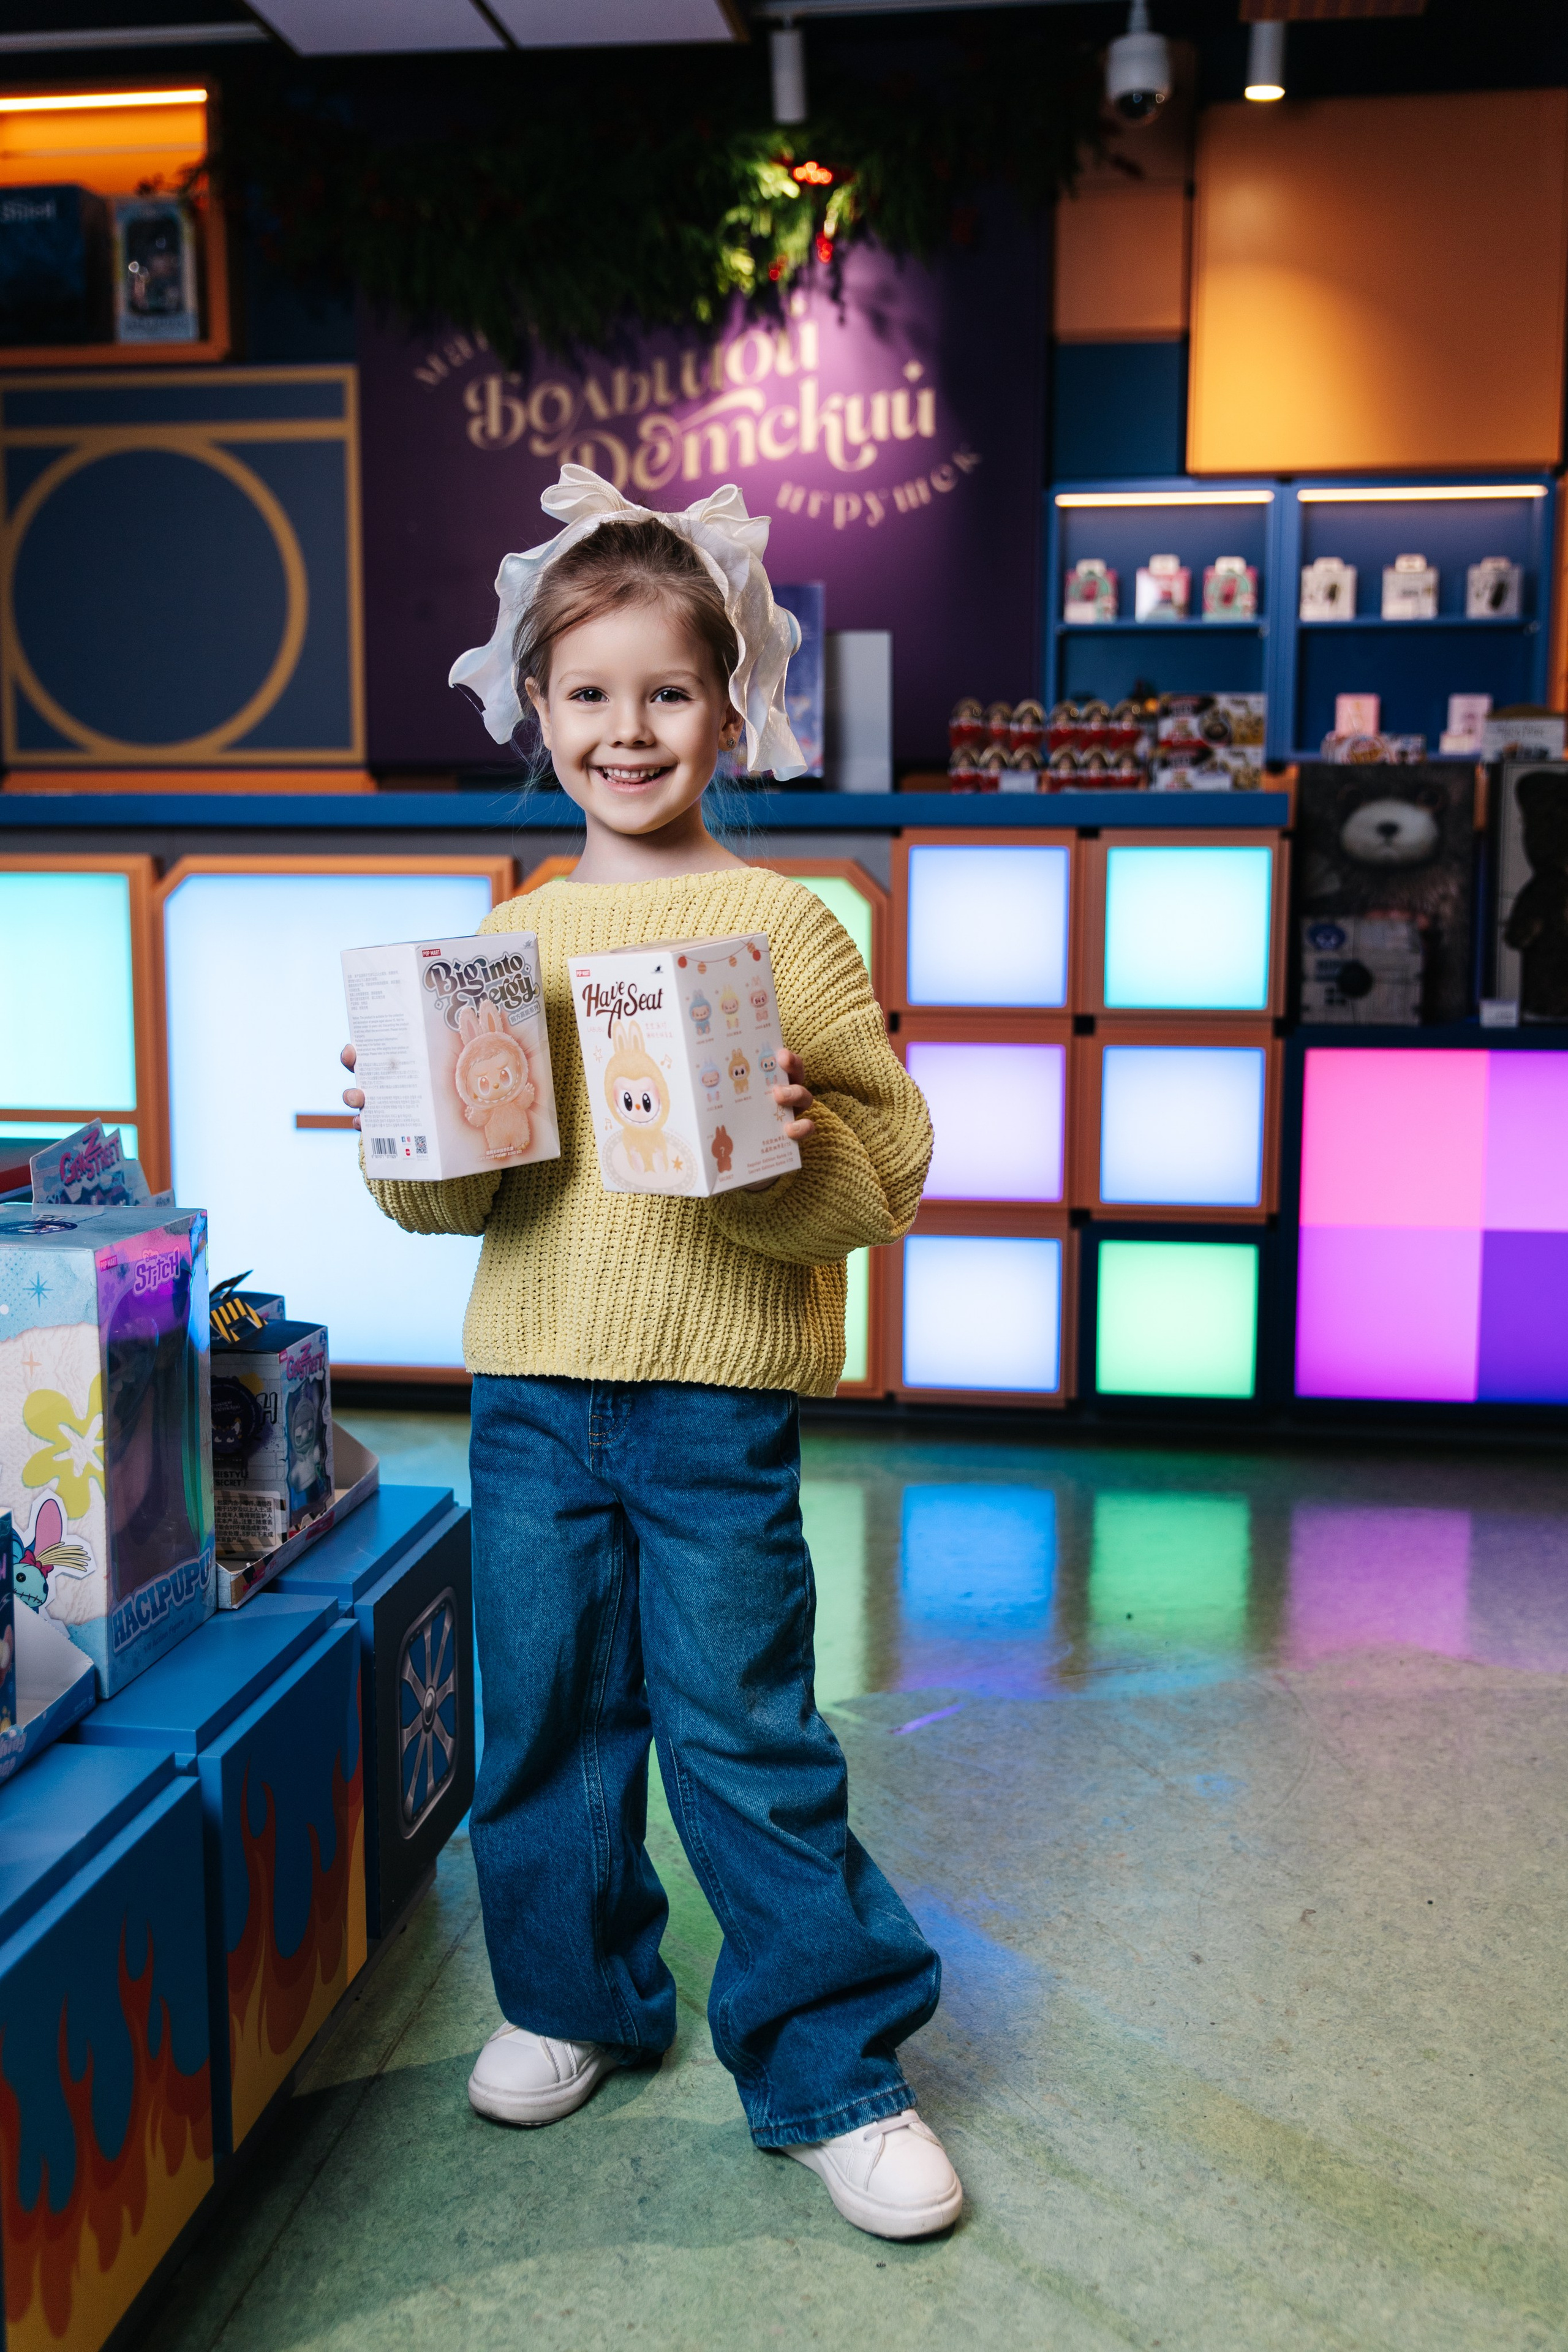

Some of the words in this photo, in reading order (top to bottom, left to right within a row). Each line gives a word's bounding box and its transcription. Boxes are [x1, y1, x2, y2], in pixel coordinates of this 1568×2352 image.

[424, 958, 486, 997] Big
[480, 955, 523, 985] into
[582, 981, 625, 1017] Have
[595, 998, 623, 1039] A
[624, 983, 663, 1017] Seat
[112, 1549, 210, 1649] HACIPUPU
